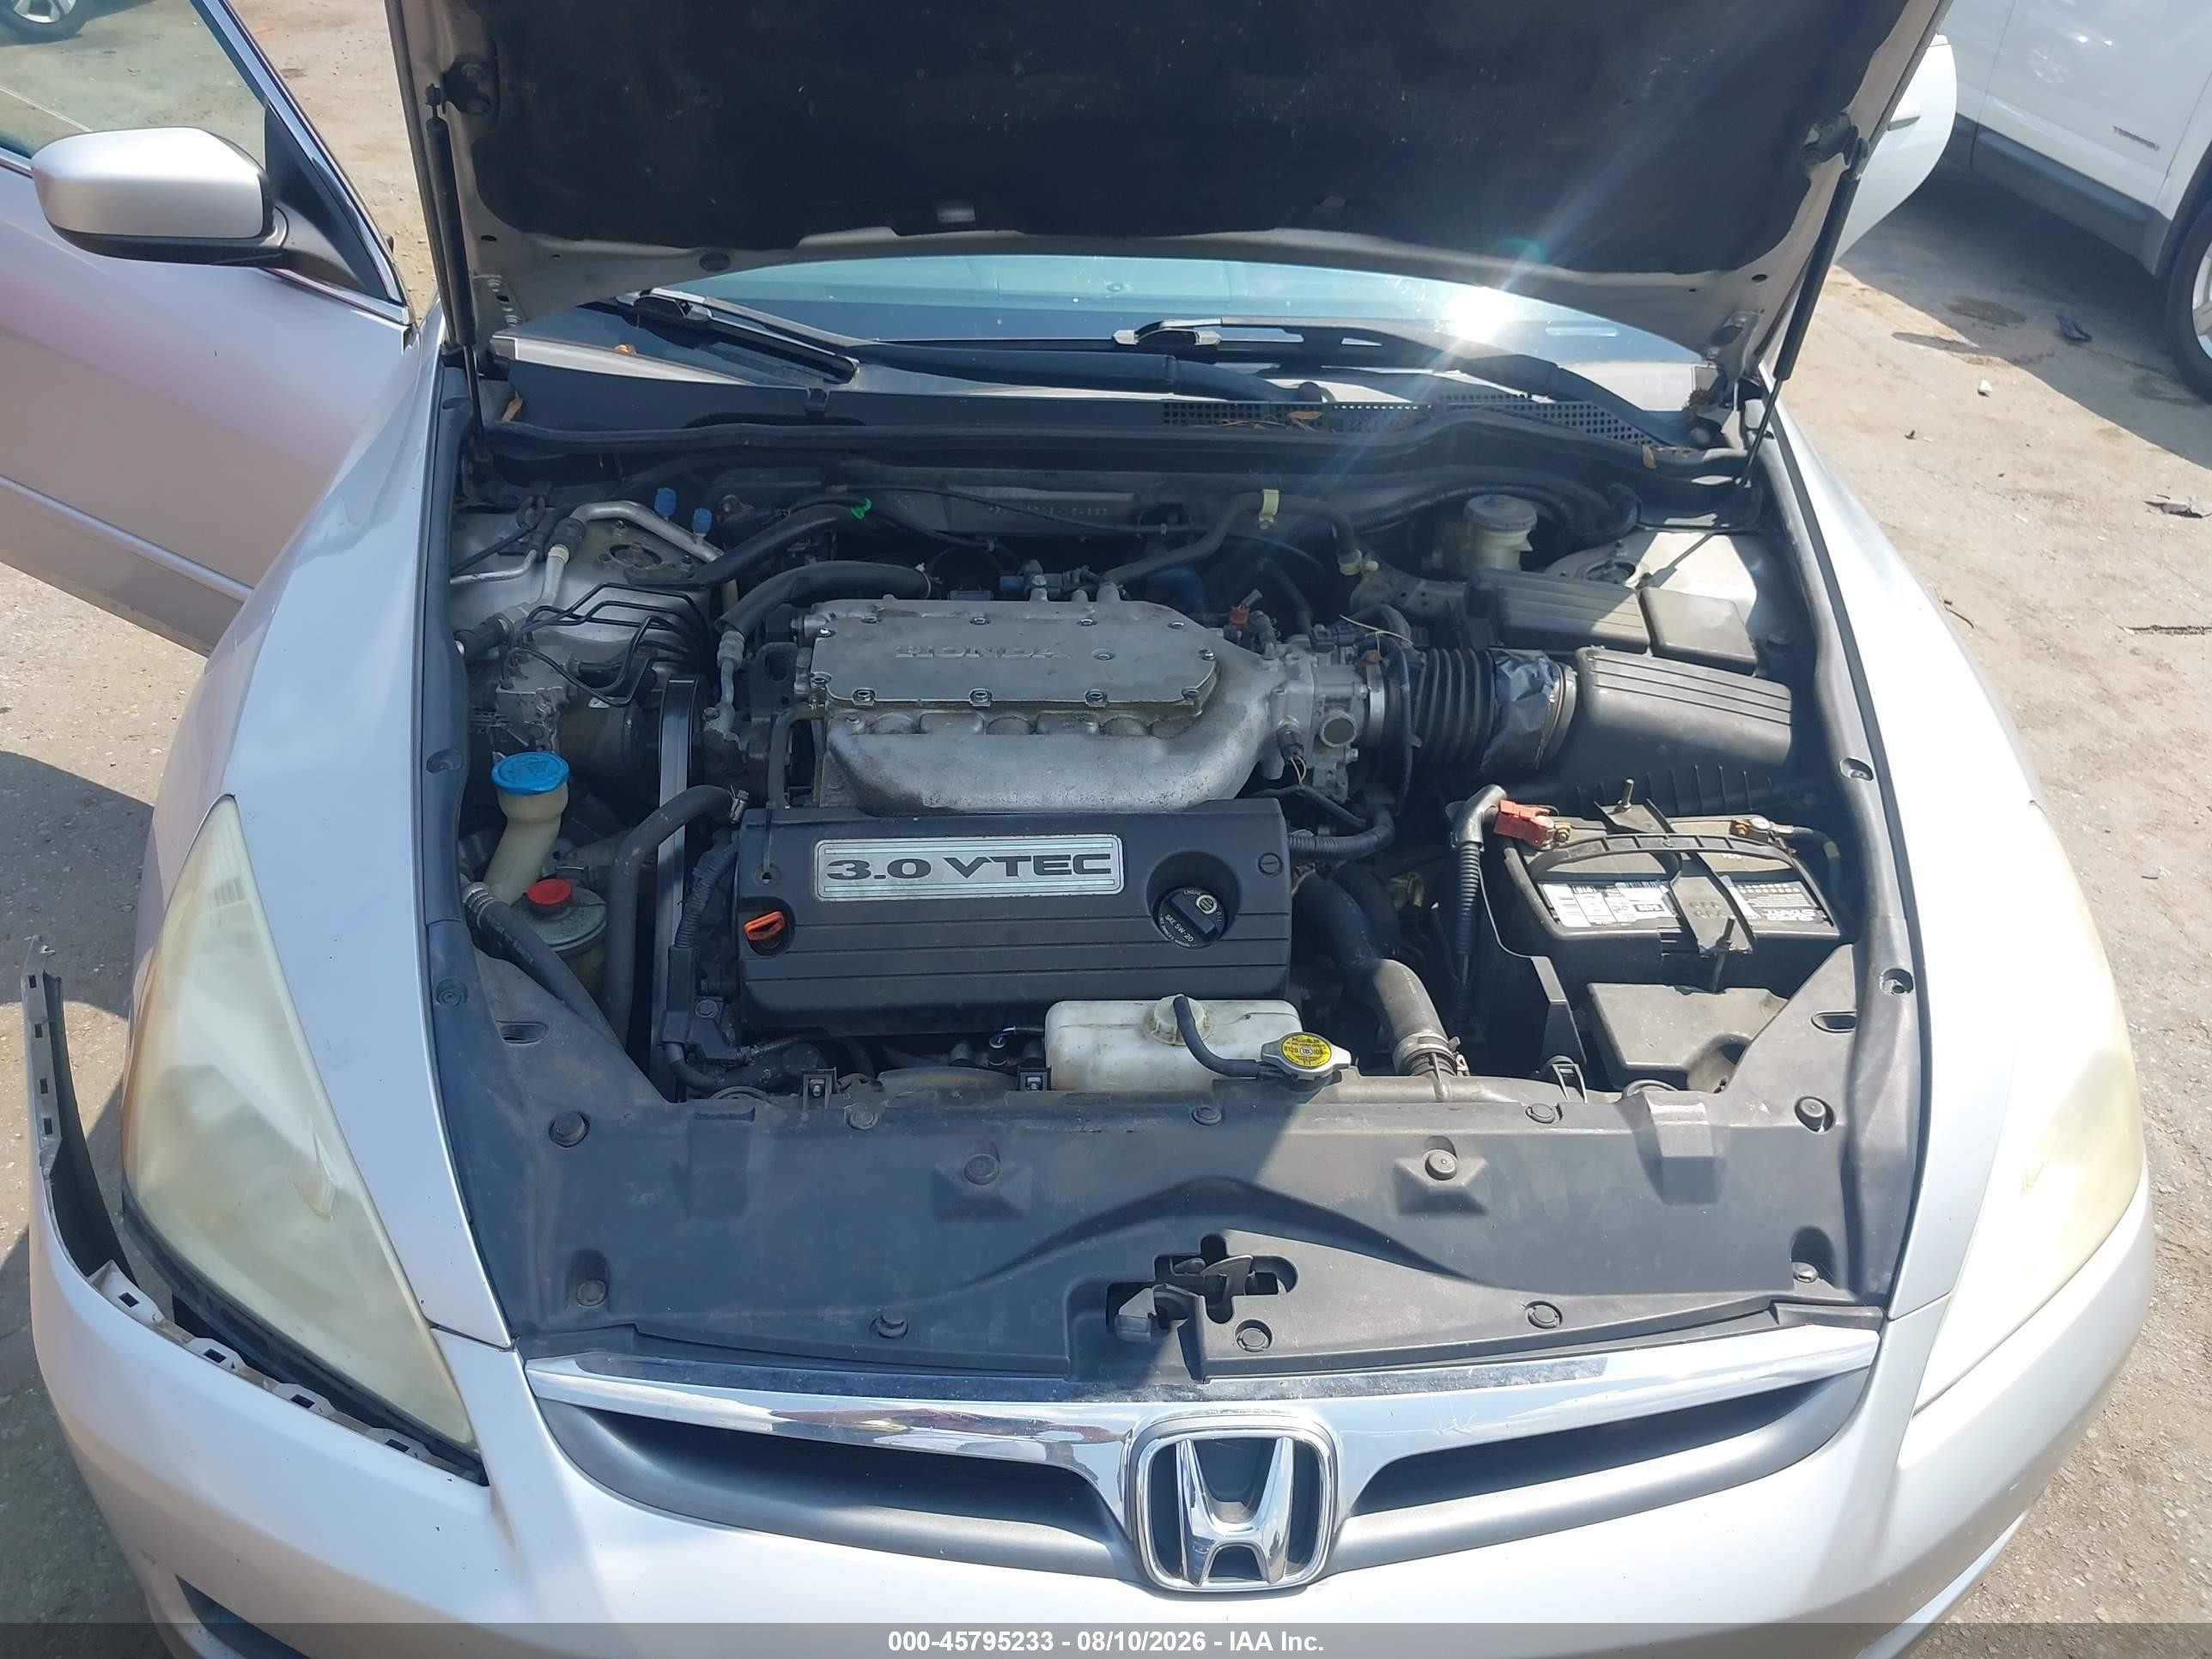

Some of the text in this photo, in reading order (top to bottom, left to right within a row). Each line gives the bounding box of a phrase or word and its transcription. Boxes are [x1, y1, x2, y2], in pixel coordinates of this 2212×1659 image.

[895, 645, 1072, 659] HONDA
[826, 854, 1112, 881] 3.0 VTEC
